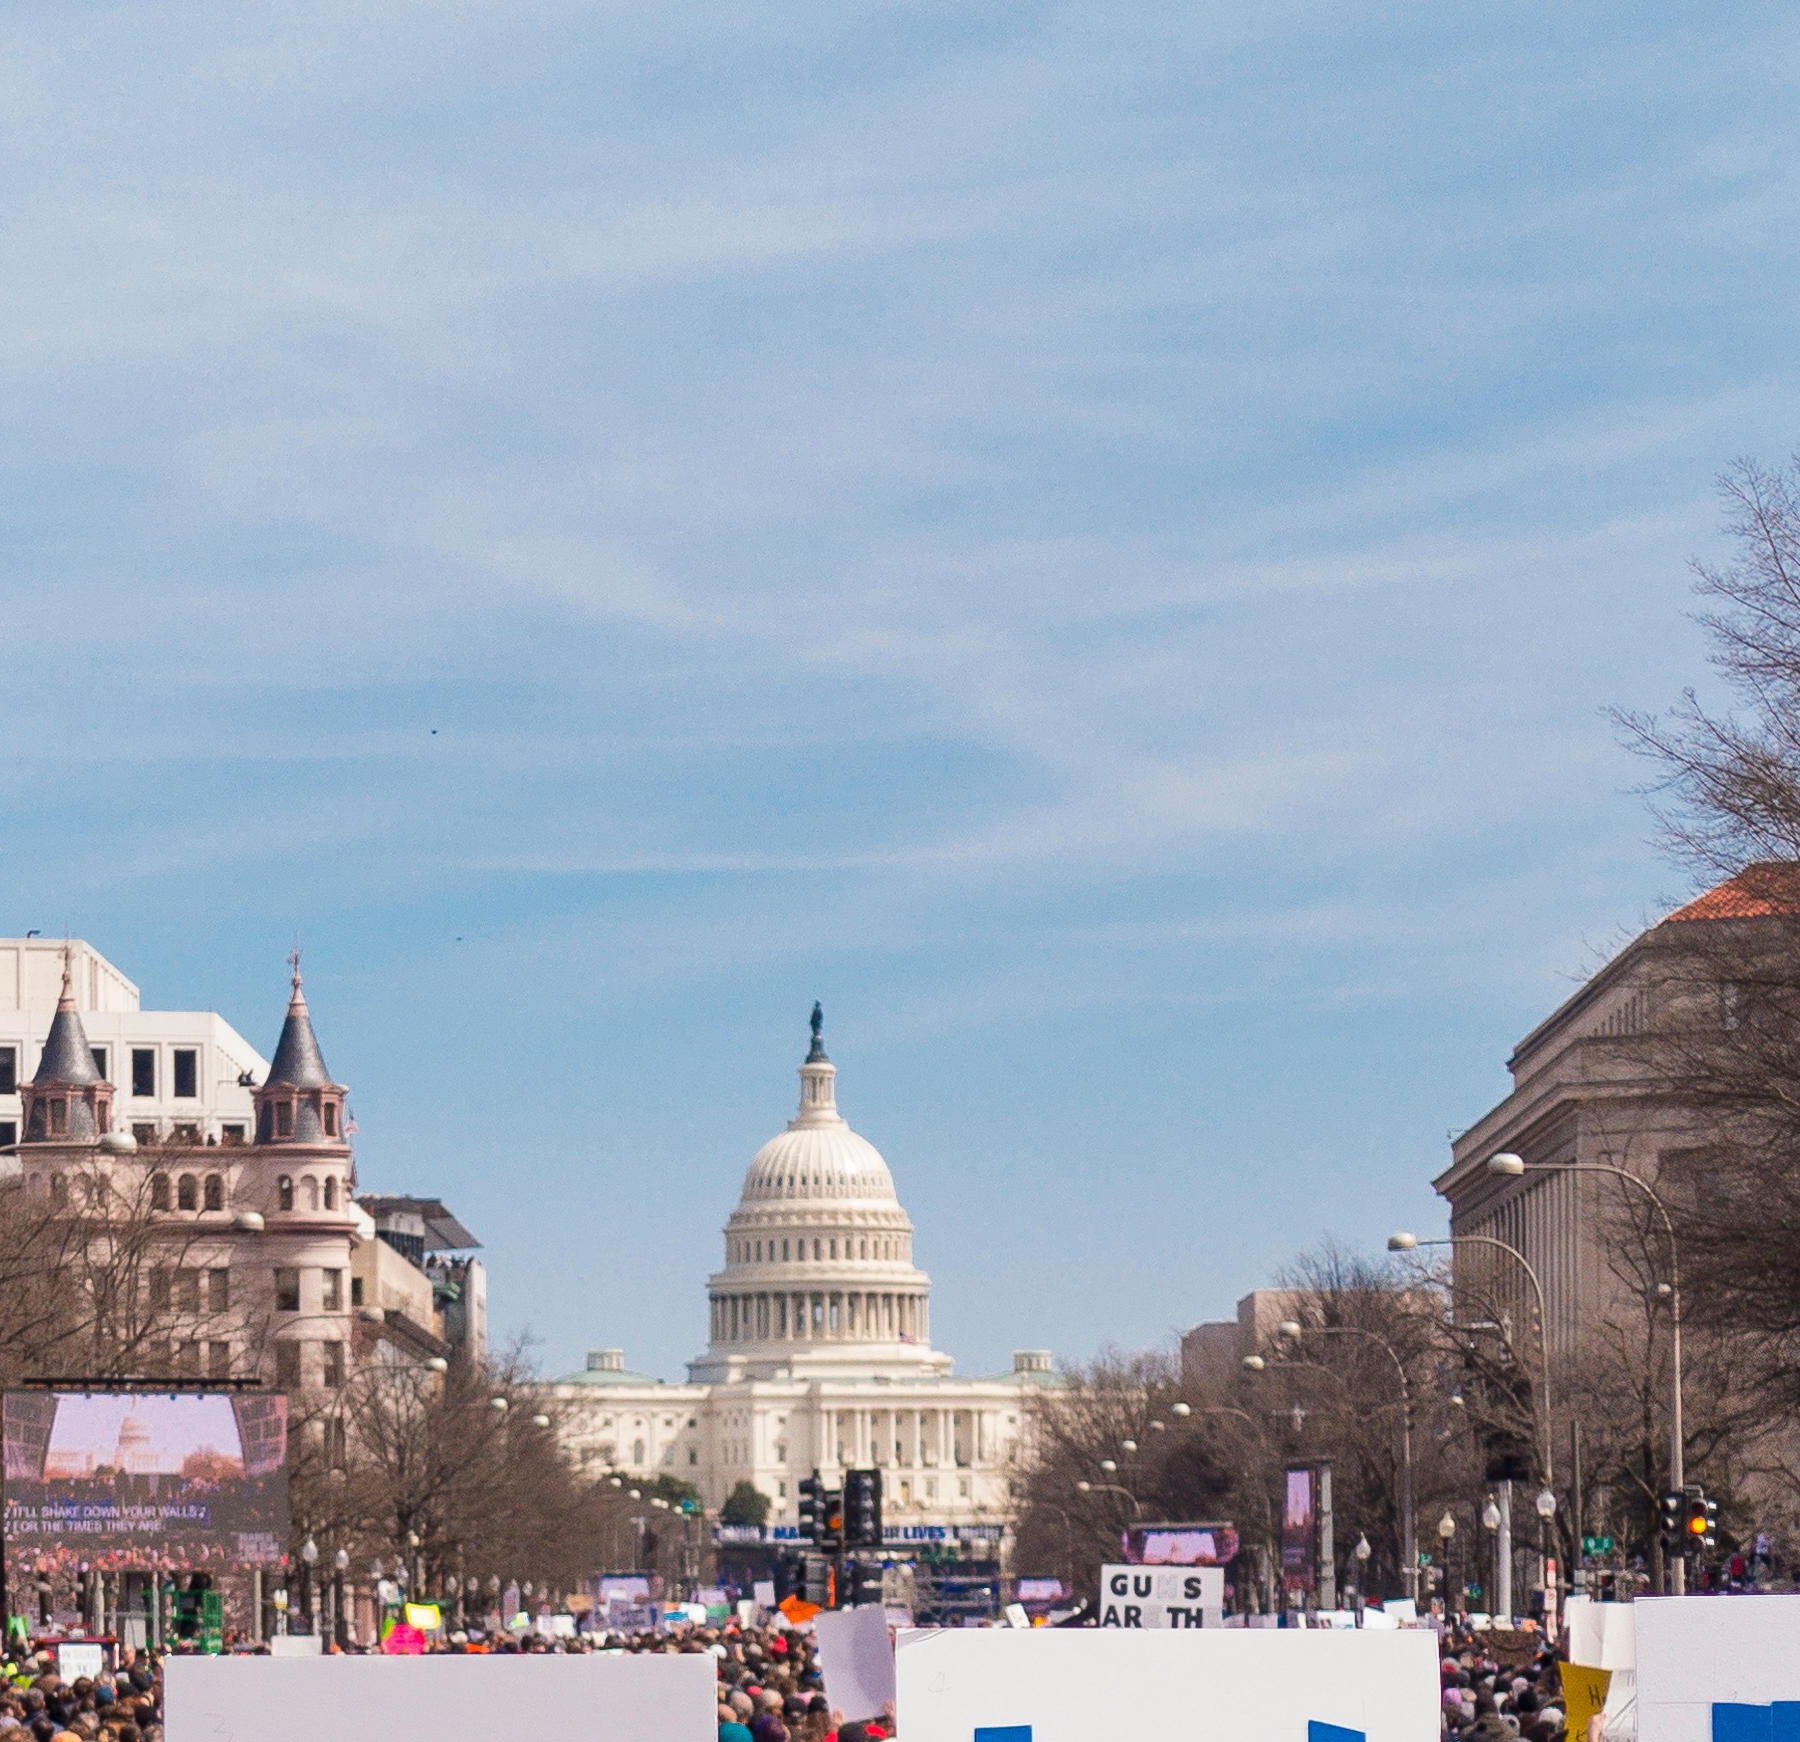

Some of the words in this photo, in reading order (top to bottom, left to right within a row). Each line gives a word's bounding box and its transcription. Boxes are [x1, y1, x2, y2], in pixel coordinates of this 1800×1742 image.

[41, 1506, 80, 1518] SHAKE
[84, 1506, 120, 1518] DOWN
[122, 1505, 156, 1517] YOUR
[158, 1505, 198, 1518] WALLS
[903, 1526, 947, 1539] LIVES
